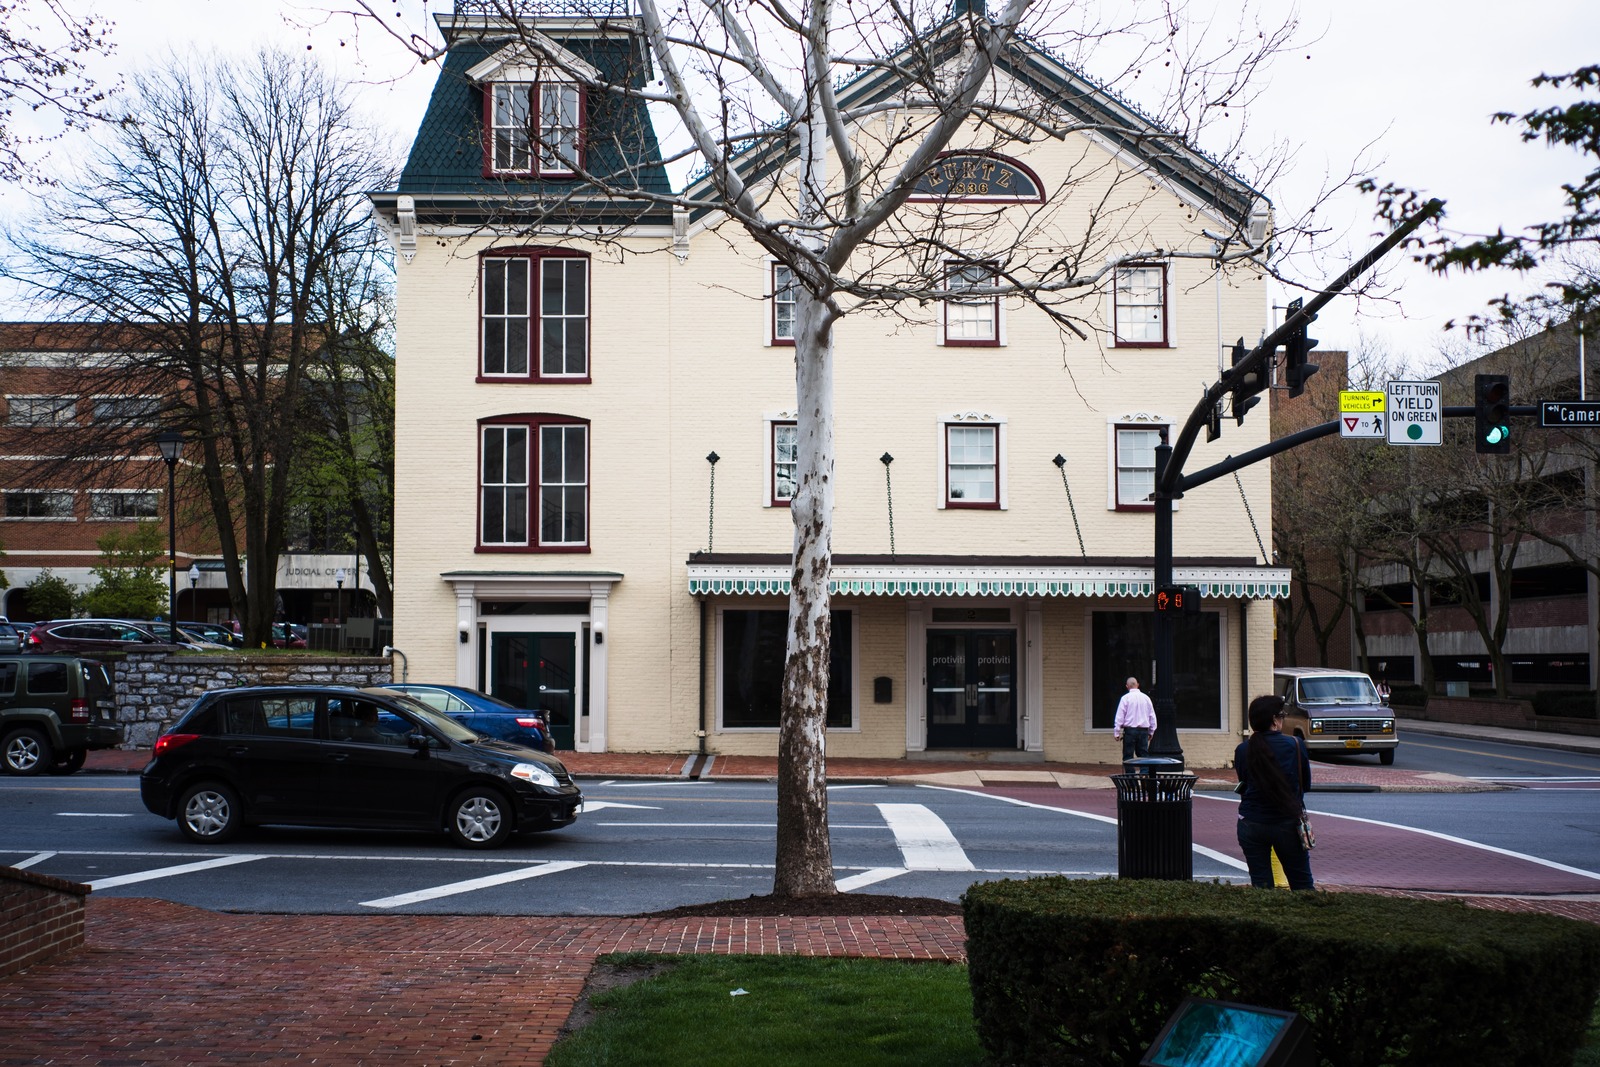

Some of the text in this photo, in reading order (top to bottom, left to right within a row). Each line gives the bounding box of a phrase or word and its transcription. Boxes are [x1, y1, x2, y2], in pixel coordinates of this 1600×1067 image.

[925, 161, 1014, 188] KURTZ
[1390, 385, 1438, 396] LEFT TURN
[1395, 397, 1433, 410] YIELD
[1392, 411, 1438, 422] ON GREEN
[1561, 407, 1600, 421] Camer
[286, 568, 357, 577] JUDICIAL CETER
[967, 610, 976, 619] 2
[932, 656, 966, 667] protiviti
[977, 656, 1011, 667] protiviti
